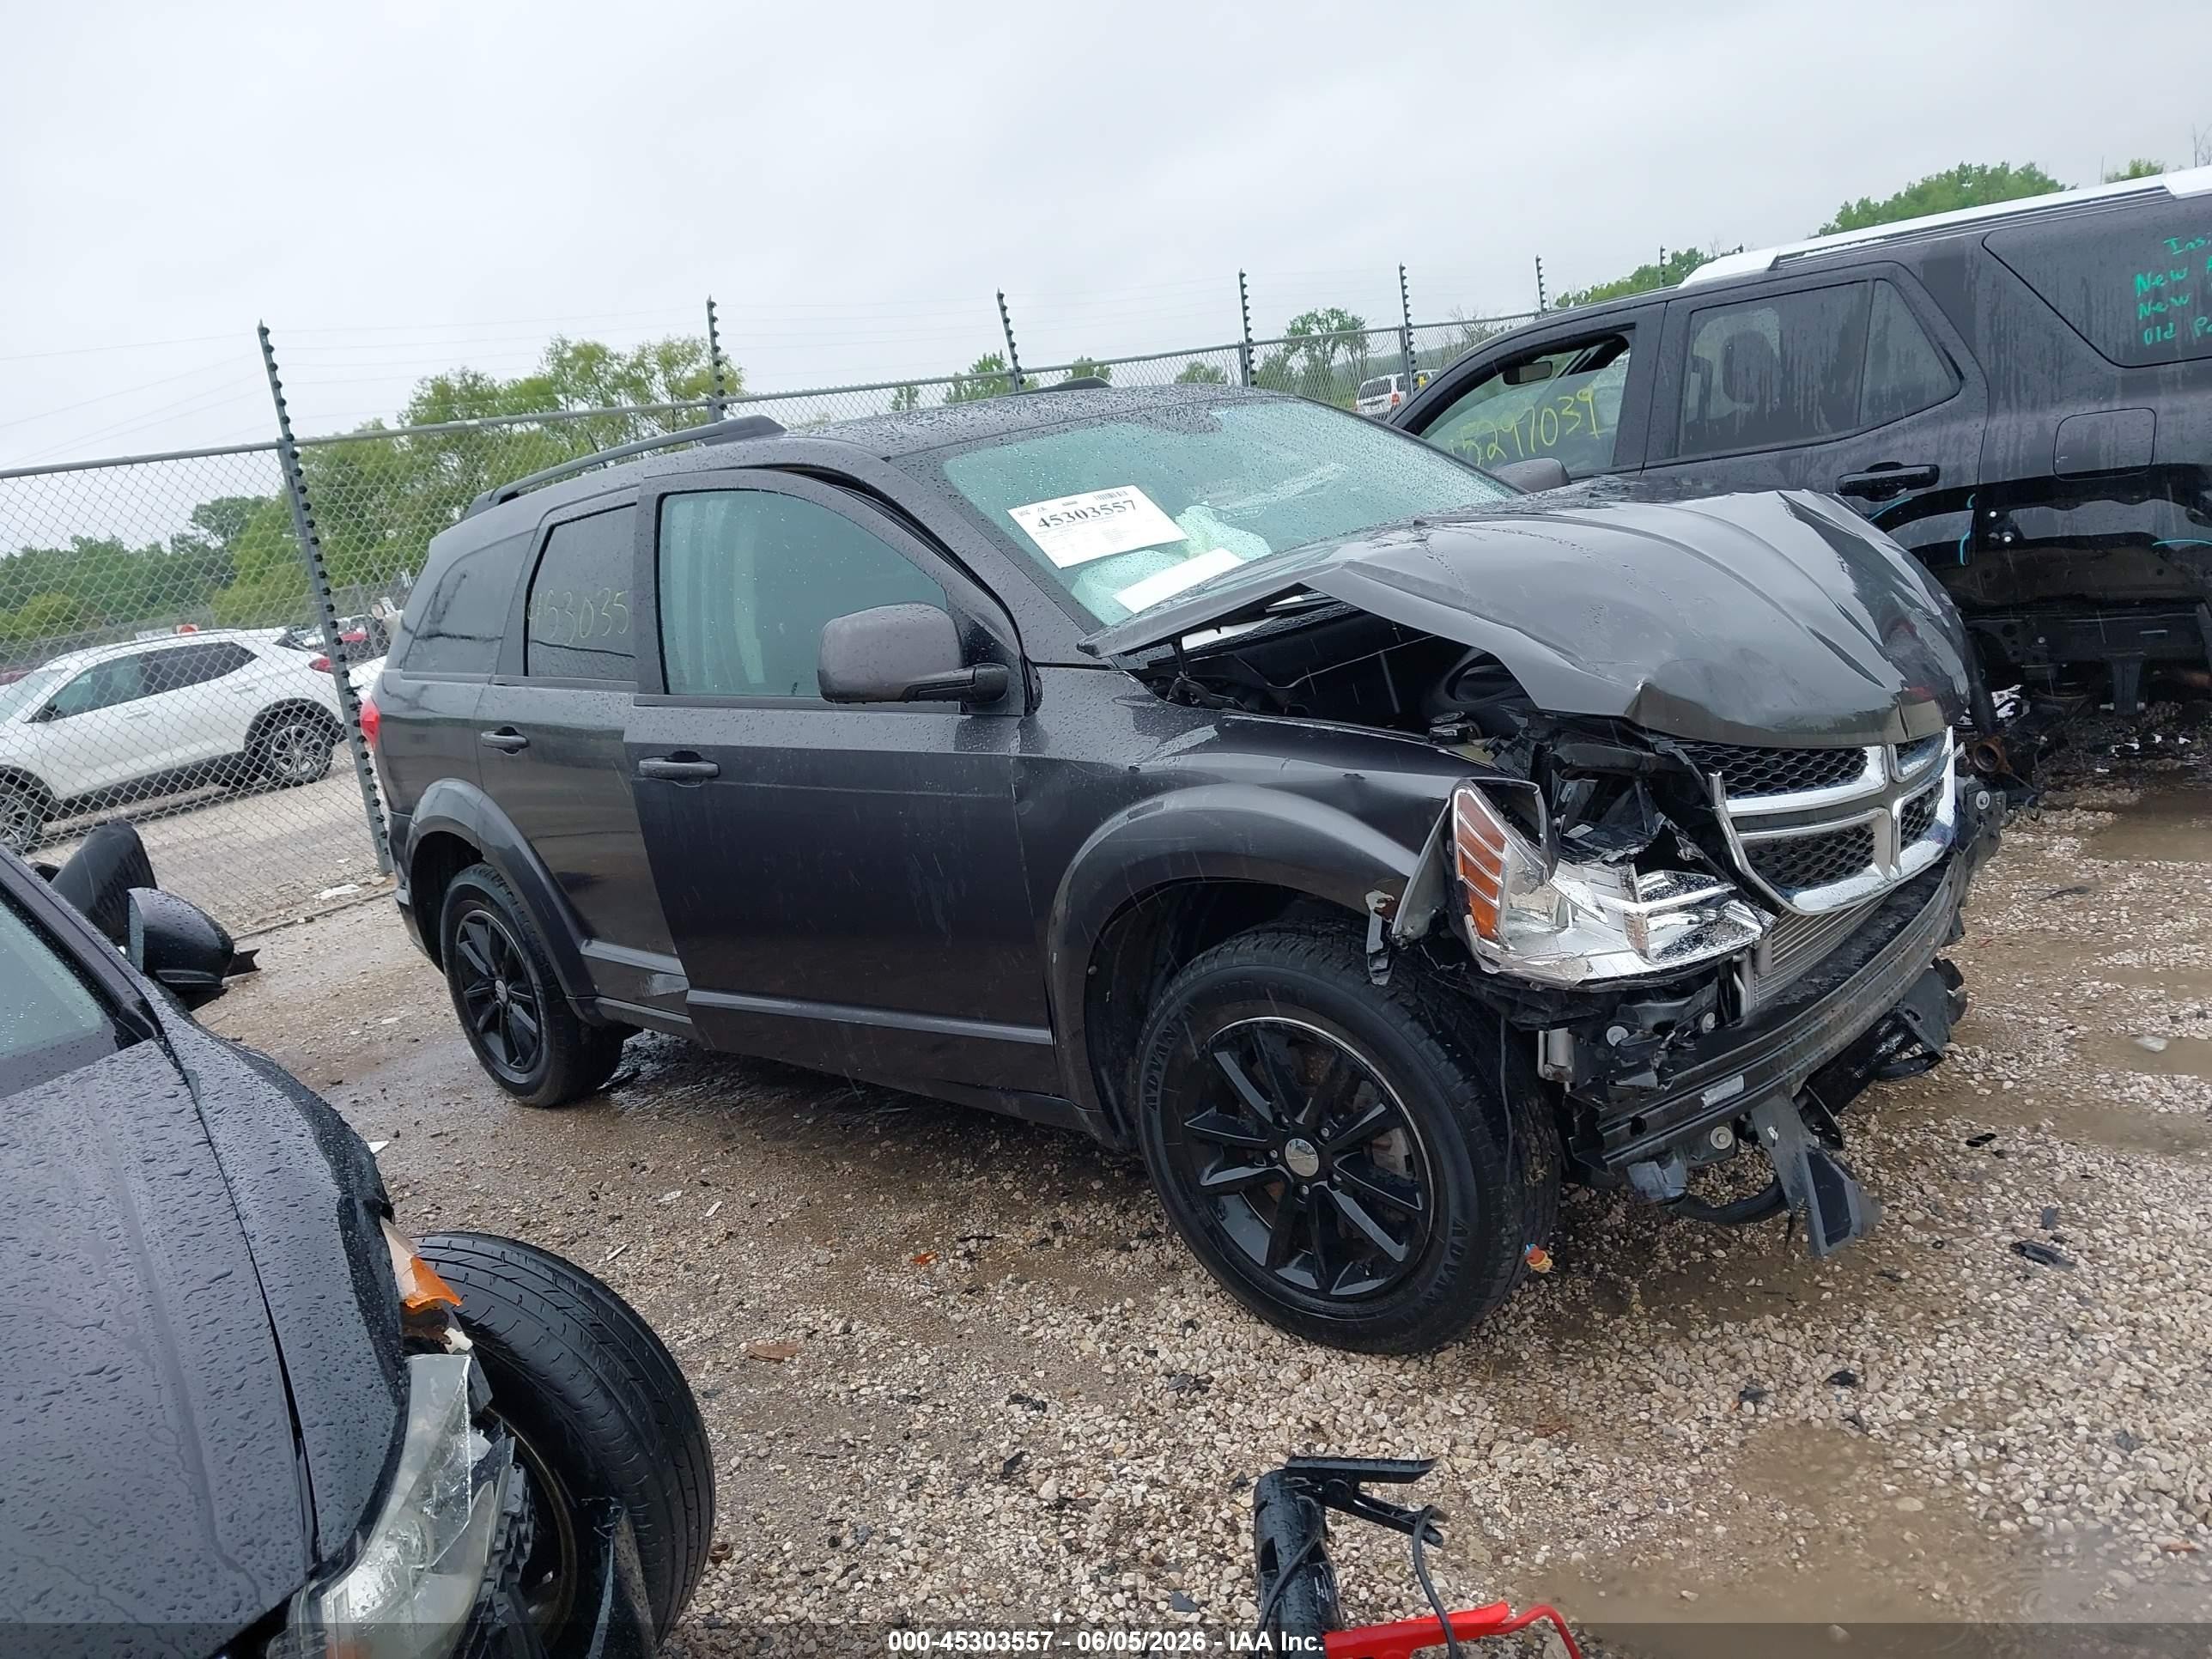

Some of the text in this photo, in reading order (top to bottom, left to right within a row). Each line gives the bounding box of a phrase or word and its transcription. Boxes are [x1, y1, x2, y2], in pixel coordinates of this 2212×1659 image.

[2135, 267, 2188, 297] New
[2138, 294, 2191, 320] New
[1036, 499, 1137, 528] 45303557
